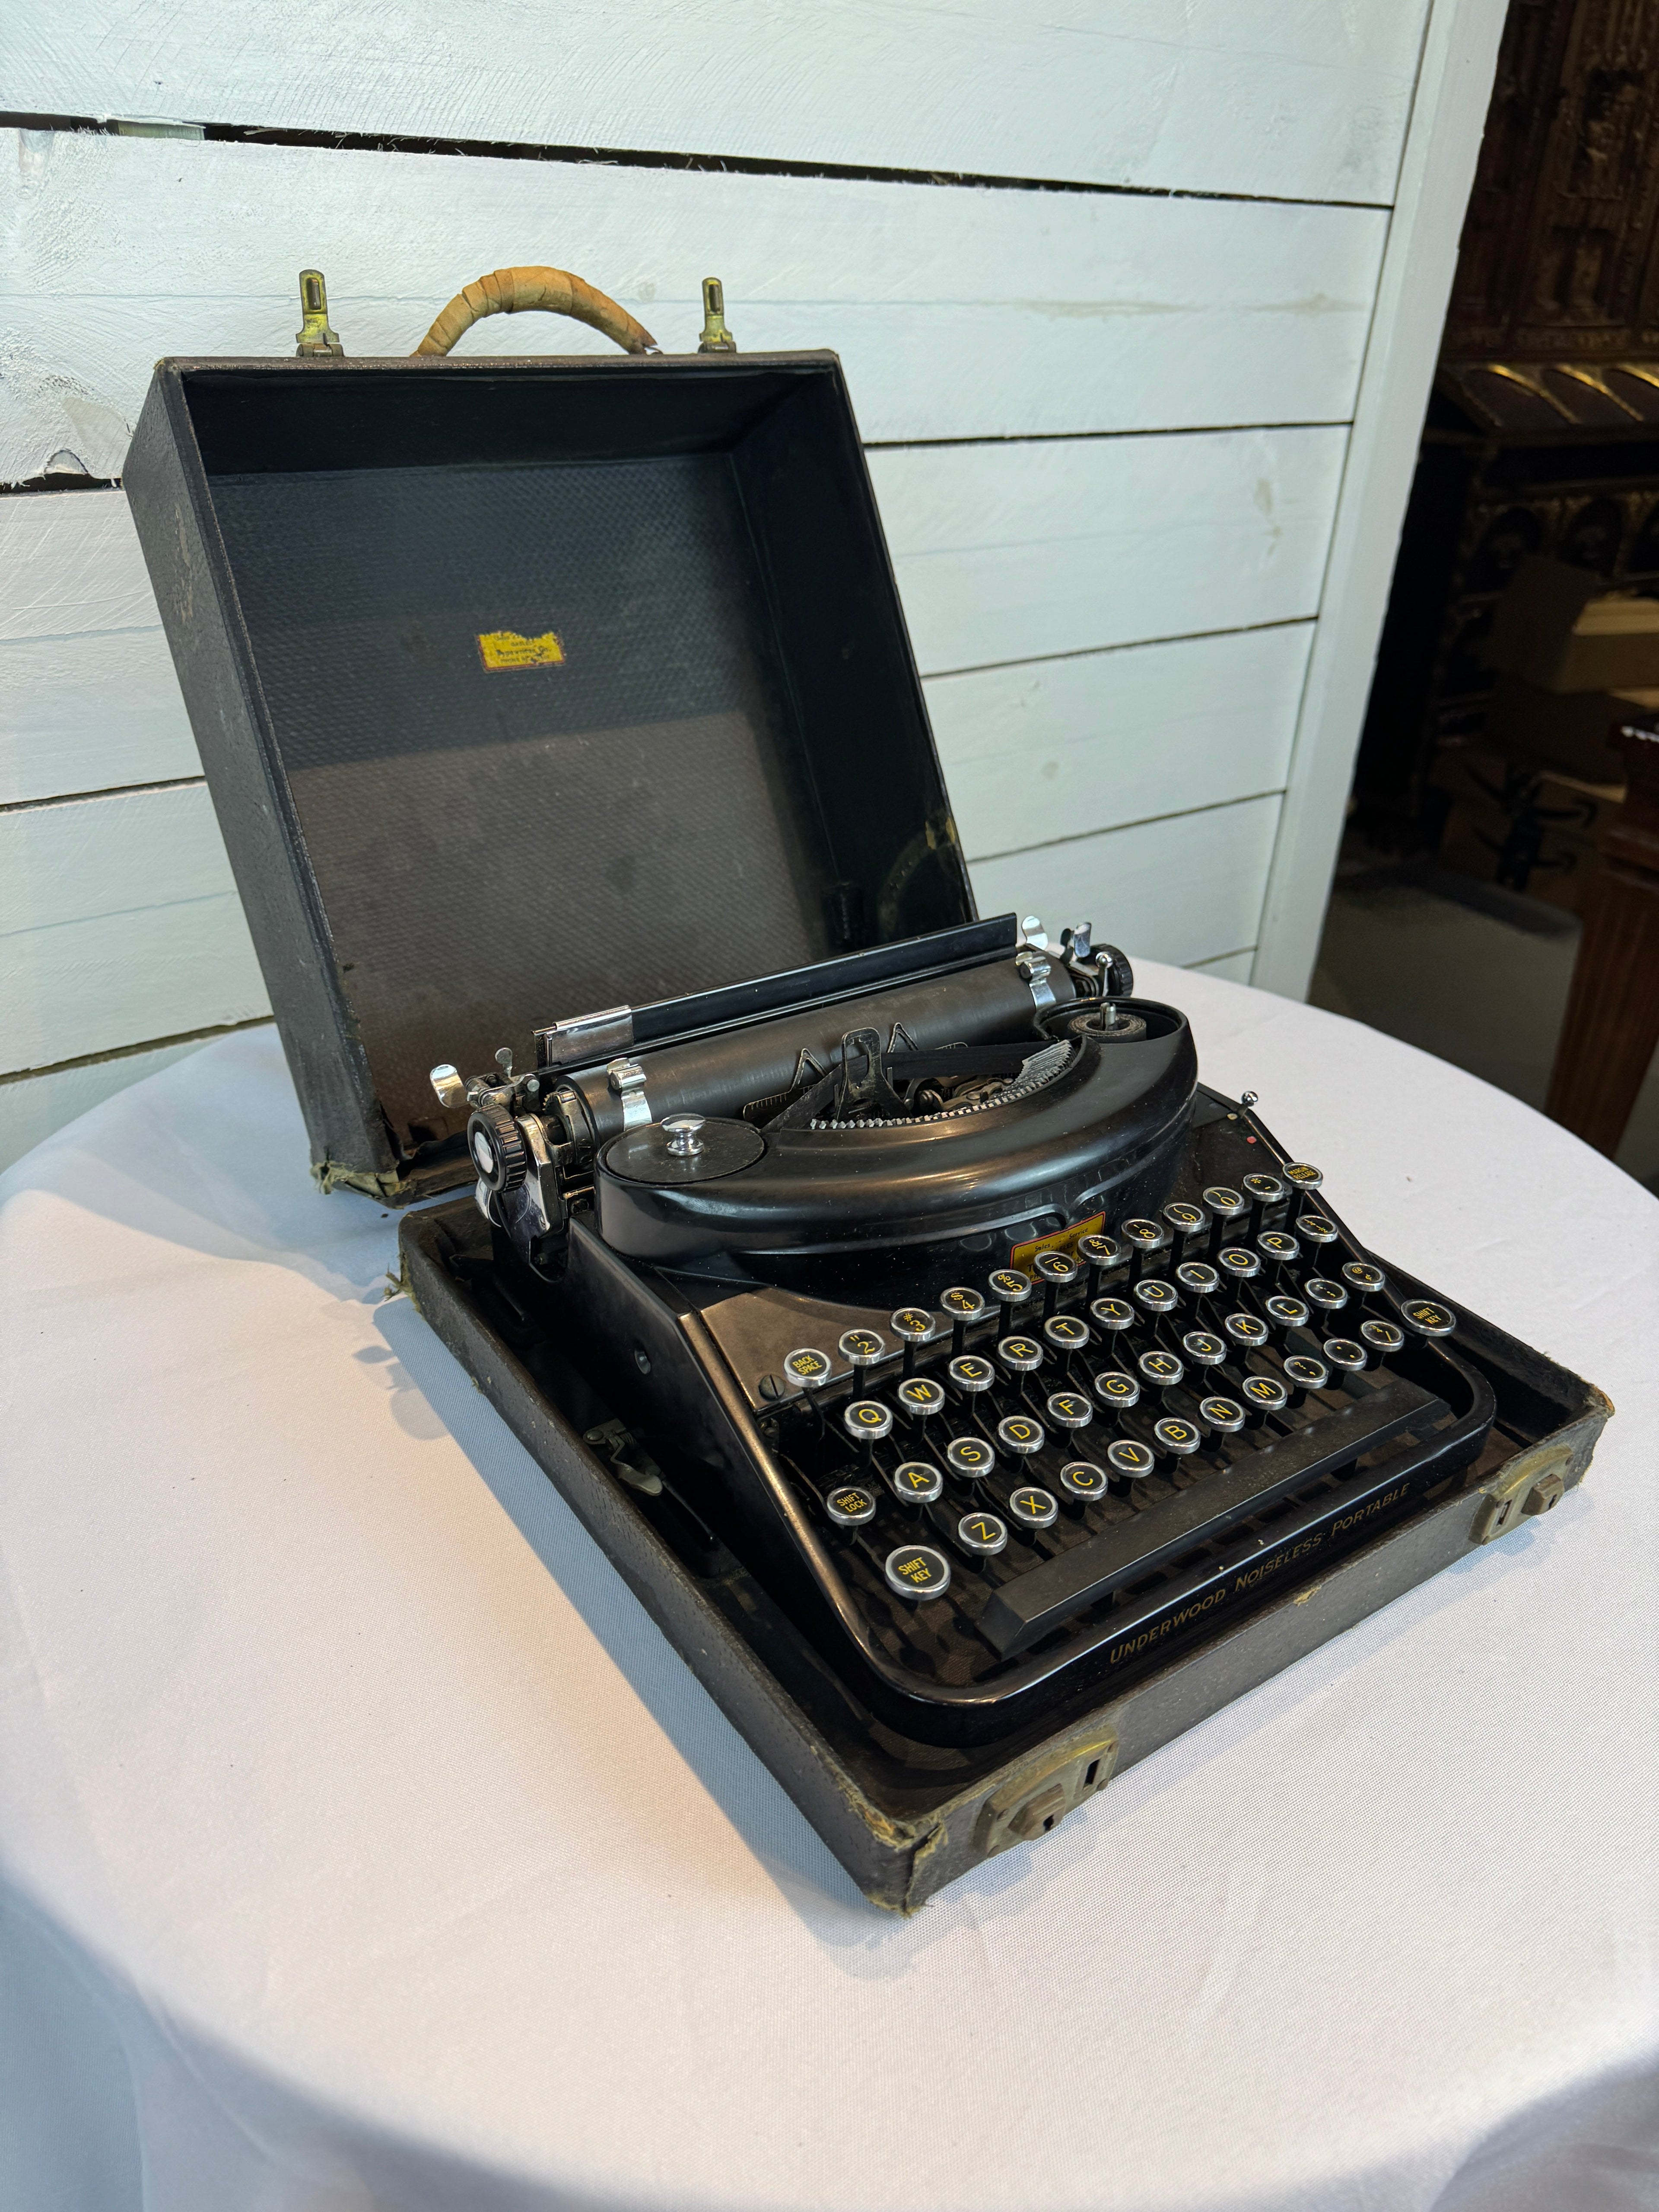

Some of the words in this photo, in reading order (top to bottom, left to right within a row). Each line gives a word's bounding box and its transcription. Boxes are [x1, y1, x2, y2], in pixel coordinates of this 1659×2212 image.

[1293, 1170, 1316, 1179] RELEASE
[1181, 1213, 1197, 1222] 9
[1069, 1227, 1089, 1239] Service
[1139, 1229, 1155, 1239] 8
[1096, 1245, 1110, 1255] 7
[1266, 1237, 1282, 1249] P
[1228, 1254, 1248, 1265] O
[1053, 1262, 1068, 1272] 6
[998, 1274, 1011, 1283] %
[1005, 1280, 1023, 1292] 5
[1144, 1285, 1164, 1297] U
[950, 1292, 964, 1300] $
[962, 1300, 975, 1310] 4
[1100, 1304, 1120, 1316] Y
[1277, 1304, 1298, 1315] L
[1413, 1307, 1433, 1319] SHIFT
[903, 1313, 912, 1322] #
[910, 1319, 926, 1332] 3
[1235, 1320, 1258, 1334] K
[1424, 1315, 1441, 1325] KEY
[1055, 1322, 1075, 1335] T
[857, 1341, 875, 1354] 2
[1009, 1343, 1033, 1357] R
[1197, 1338, 1212, 1351] J
[792, 1355, 814, 1369] BACK
[798, 1360, 822, 1375] SPACE
[1148, 1358, 1172, 1373] H
[960, 1362, 982, 1377] E
[906, 1384, 931, 1401] W
[1106, 1379, 1128, 1393] G
[1250, 1382, 1275, 1398] M
[1058, 1399, 1074, 1415] F
[1209, 1404, 1232, 1419] N
[858, 1408, 882, 1424] Q
[1009, 1424, 1031, 1440] D
[1164, 1425, 1187, 1440] B
[960, 1446, 982, 1462] S
[1118, 1447, 1140, 1462] V
[908, 1472, 930, 1488] A
[1072, 1471, 1093, 1486] C
[836, 1493, 859, 1507] SHIFT
[845, 1500, 867, 1513] LOCK
[1020, 1496, 1046, 1515] X
[971, 1522, 996, 1541] Z
[898, 1557, 926, 1575] SHIFT
[910, 1568, 931, 1583] KEY
[1110, 1589, 1226, 1664] UNDERWOOD
[1234, 1532, 1322, 1592] NOISELESS
[1330, 1483, 1410, 1537] PORTABLE
